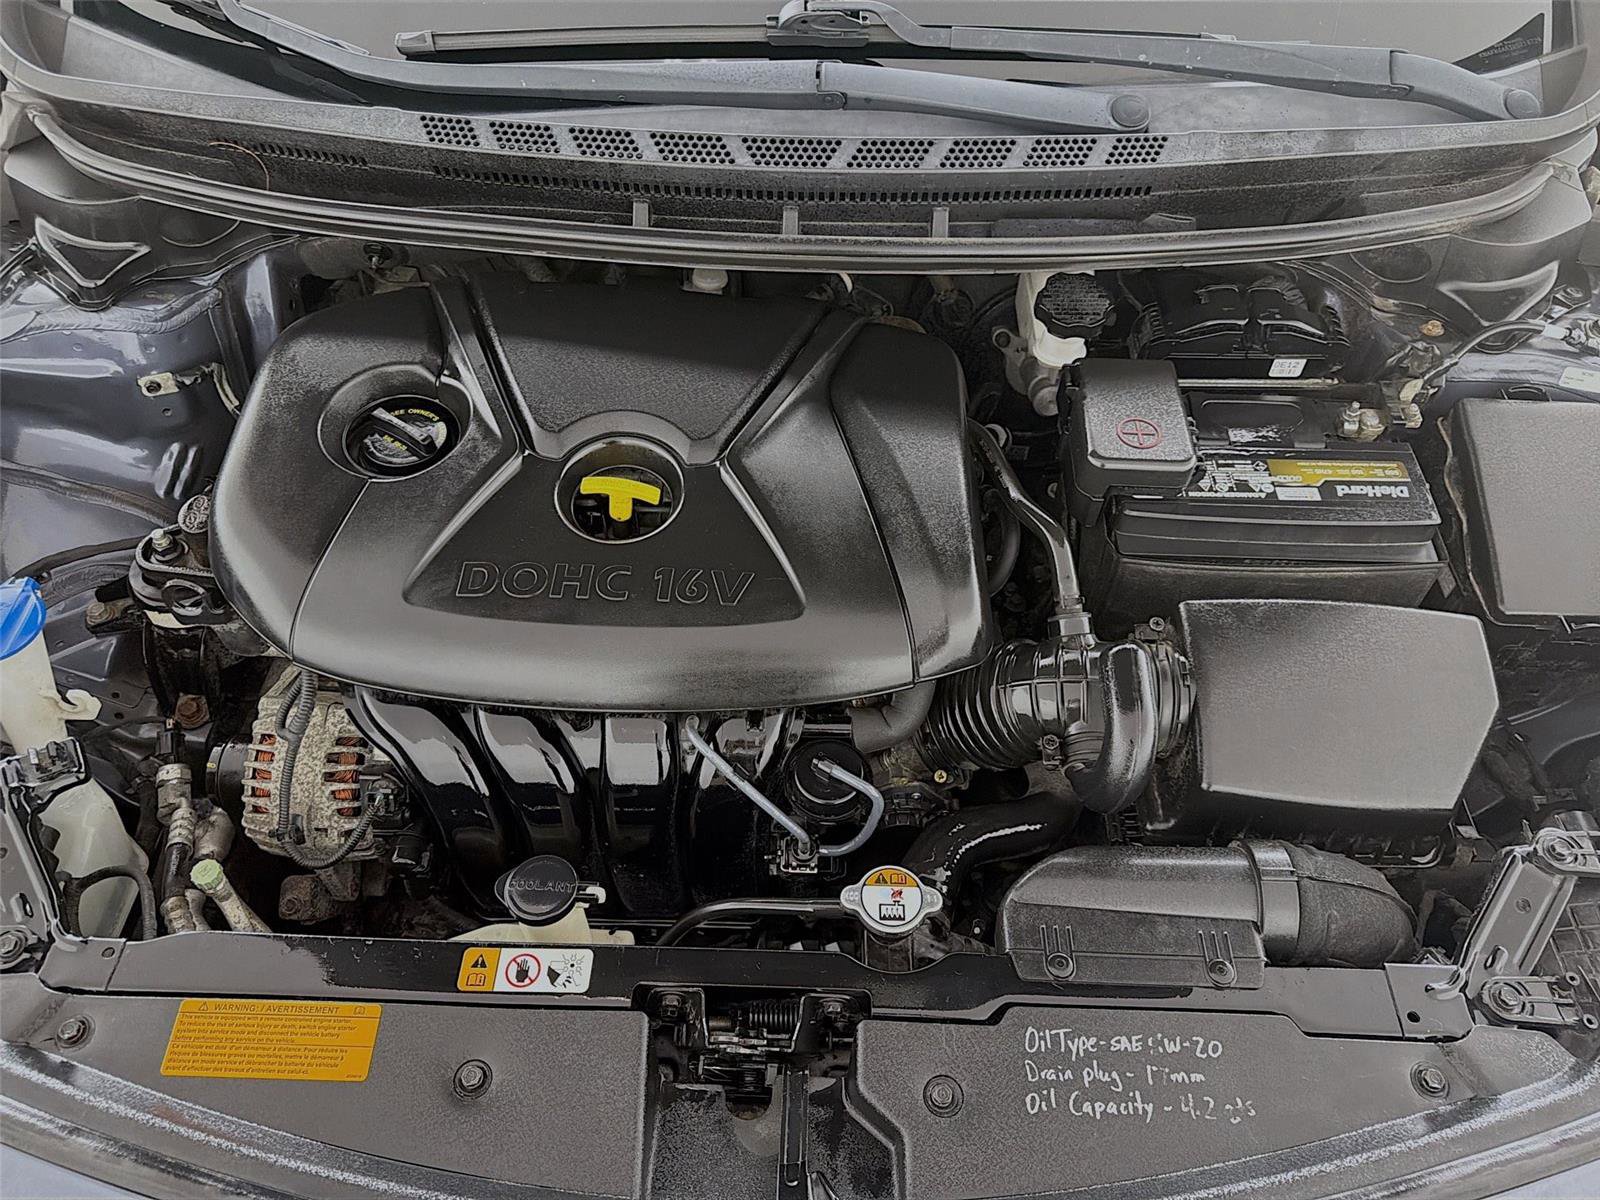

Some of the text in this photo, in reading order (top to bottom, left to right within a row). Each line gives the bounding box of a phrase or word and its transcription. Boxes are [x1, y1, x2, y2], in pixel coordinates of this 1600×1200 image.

[1334, 485, 1410, 498] DieHard
[456, 562, 755, 606] DOHC 16V
[508, 879, 575, 893] COOLANT
[267, 1005, 340, 1014] AVERTISSEMENT
[1025, 1026, 1051, 1053] Oil
[1025, 1059, 1073, 1082] Drain
[1025, 1087, 1056, 1115] Oil
[1069, 1090, 1153, 1123] Capacity
